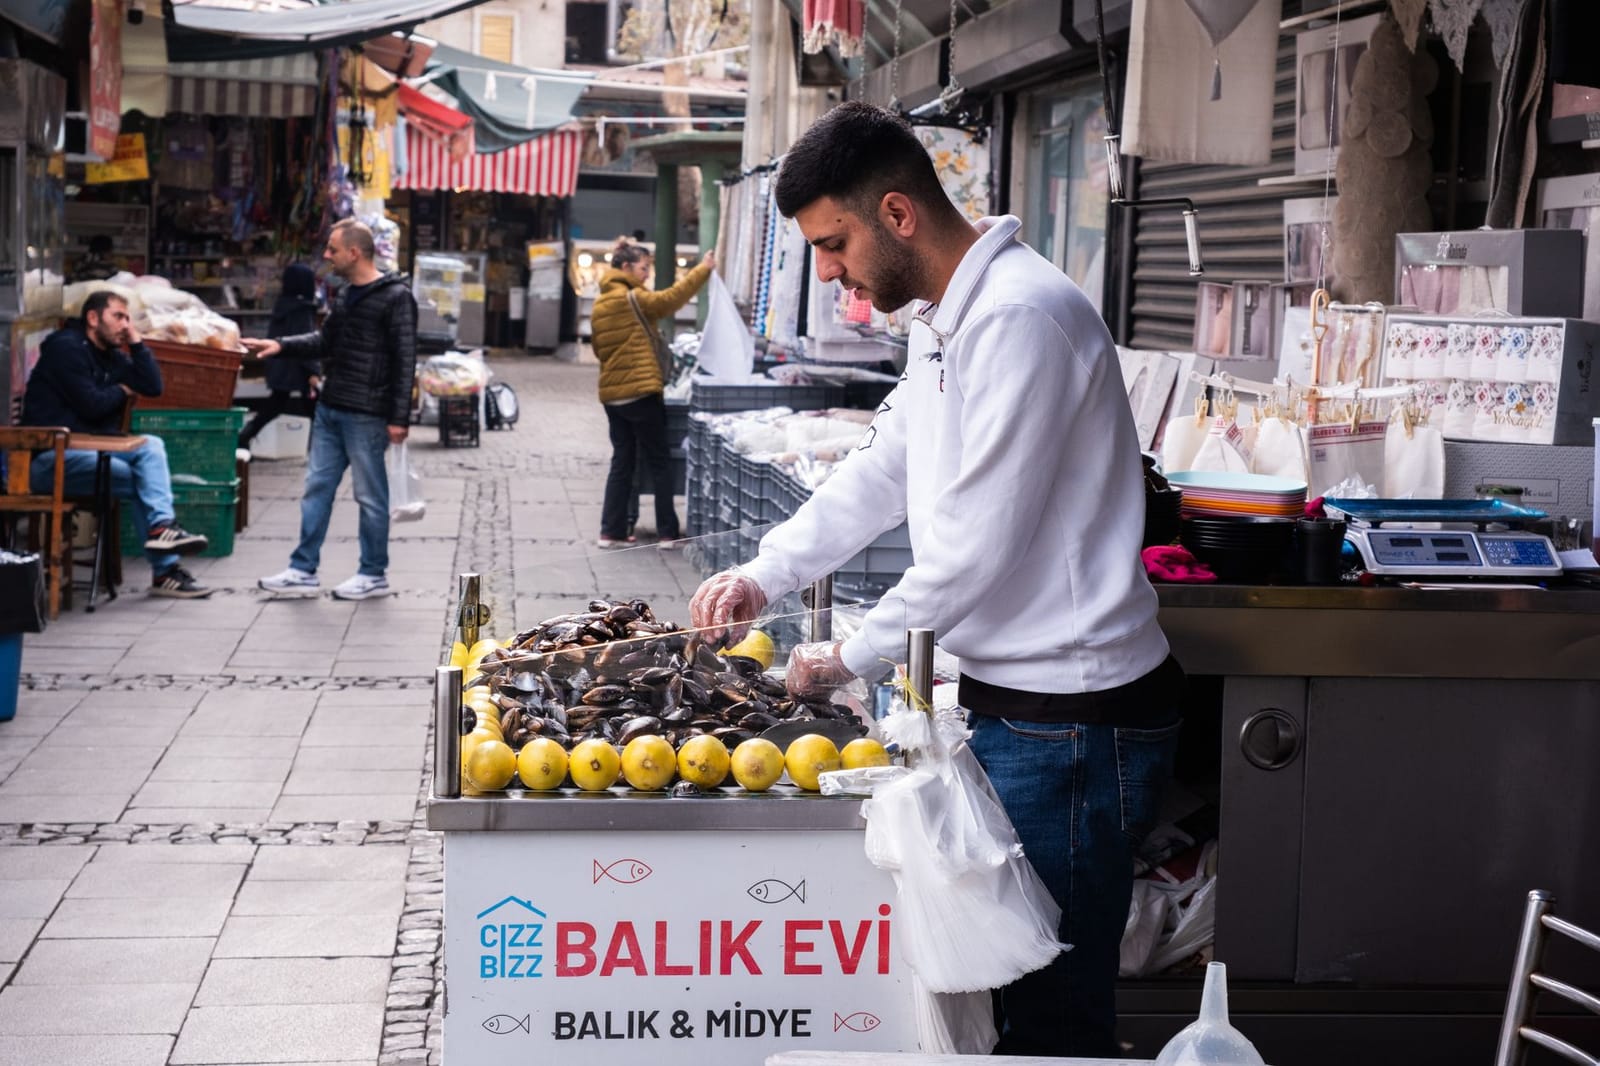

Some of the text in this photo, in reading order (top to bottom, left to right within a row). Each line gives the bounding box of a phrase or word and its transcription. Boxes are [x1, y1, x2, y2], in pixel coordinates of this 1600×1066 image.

[480, 924, 543, 948] CIZZ
[555, 903, 892, 977] BALIK EVİ
[480, 955, 543, 979] BIZZ
[554, 1001, 812, 1040] BALIK & MİDYE
